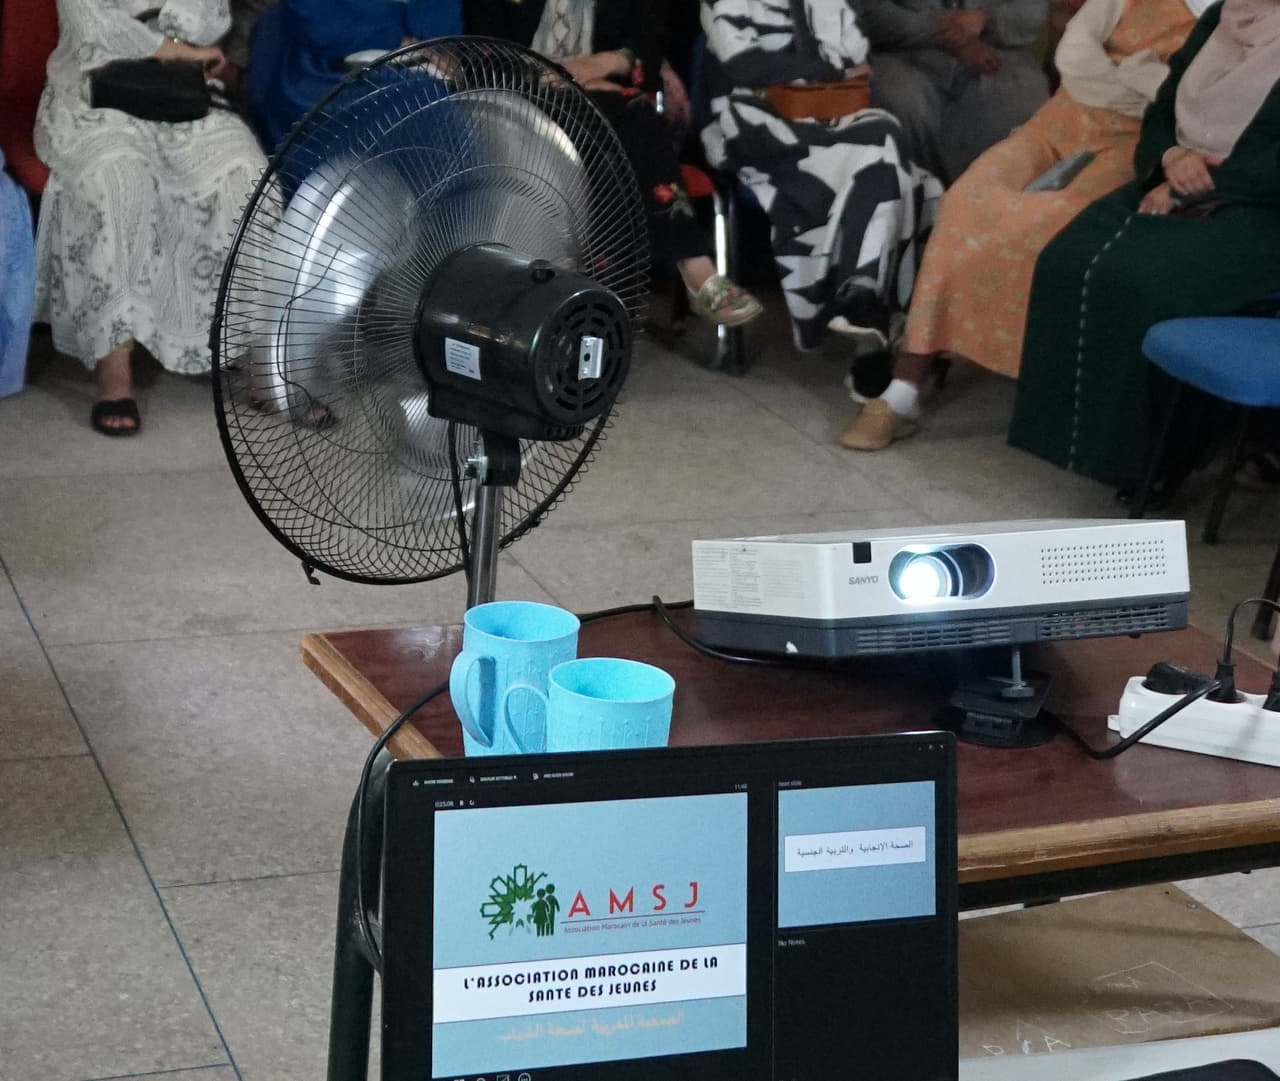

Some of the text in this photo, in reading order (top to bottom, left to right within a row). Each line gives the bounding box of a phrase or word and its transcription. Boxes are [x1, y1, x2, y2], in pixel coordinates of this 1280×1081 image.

[848, 576, 879, 586] SANYO
[464, 956, 719, 989] L'ASSOCIATION MAROCAINE DE LA
[528, 979, 657, 1003] SANTE DES JEUNES
